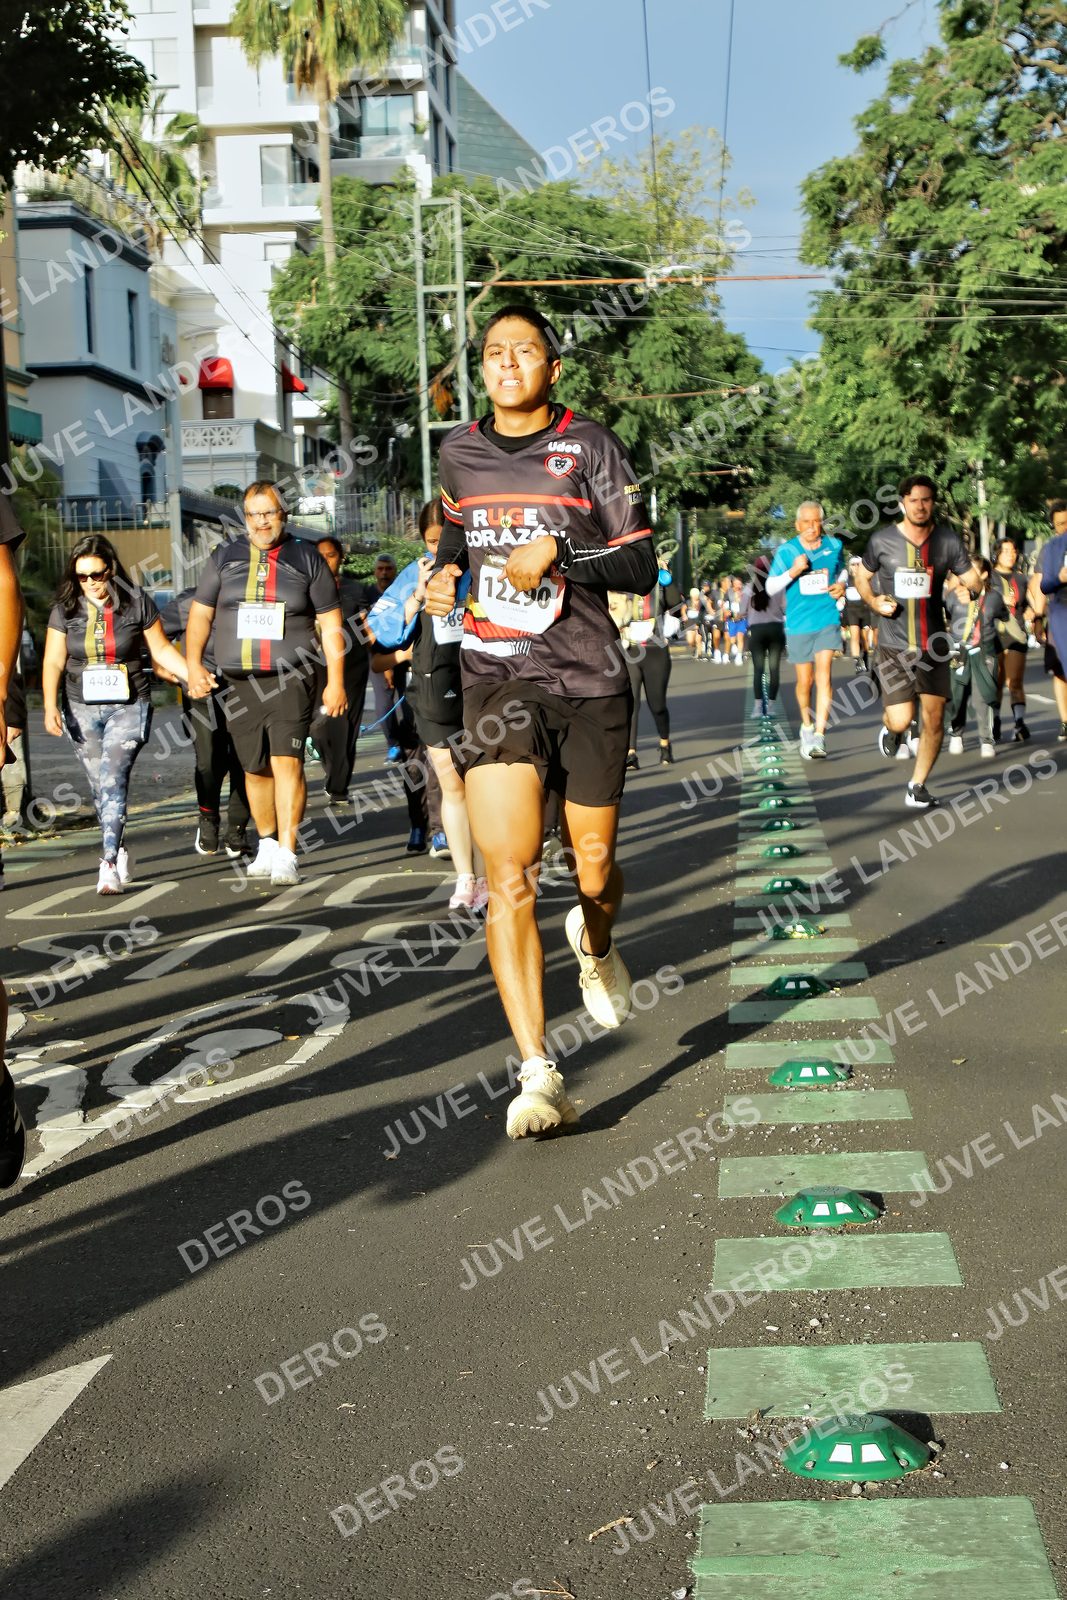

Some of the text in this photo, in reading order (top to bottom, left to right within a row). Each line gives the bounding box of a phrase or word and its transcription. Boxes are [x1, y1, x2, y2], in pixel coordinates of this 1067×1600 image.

[472, 507, 539, 527] RUGE
[901, 576, 925, 587] 9042
[244, 614, 274, 626] 4480
[89, 674, 118, 687] 4482
